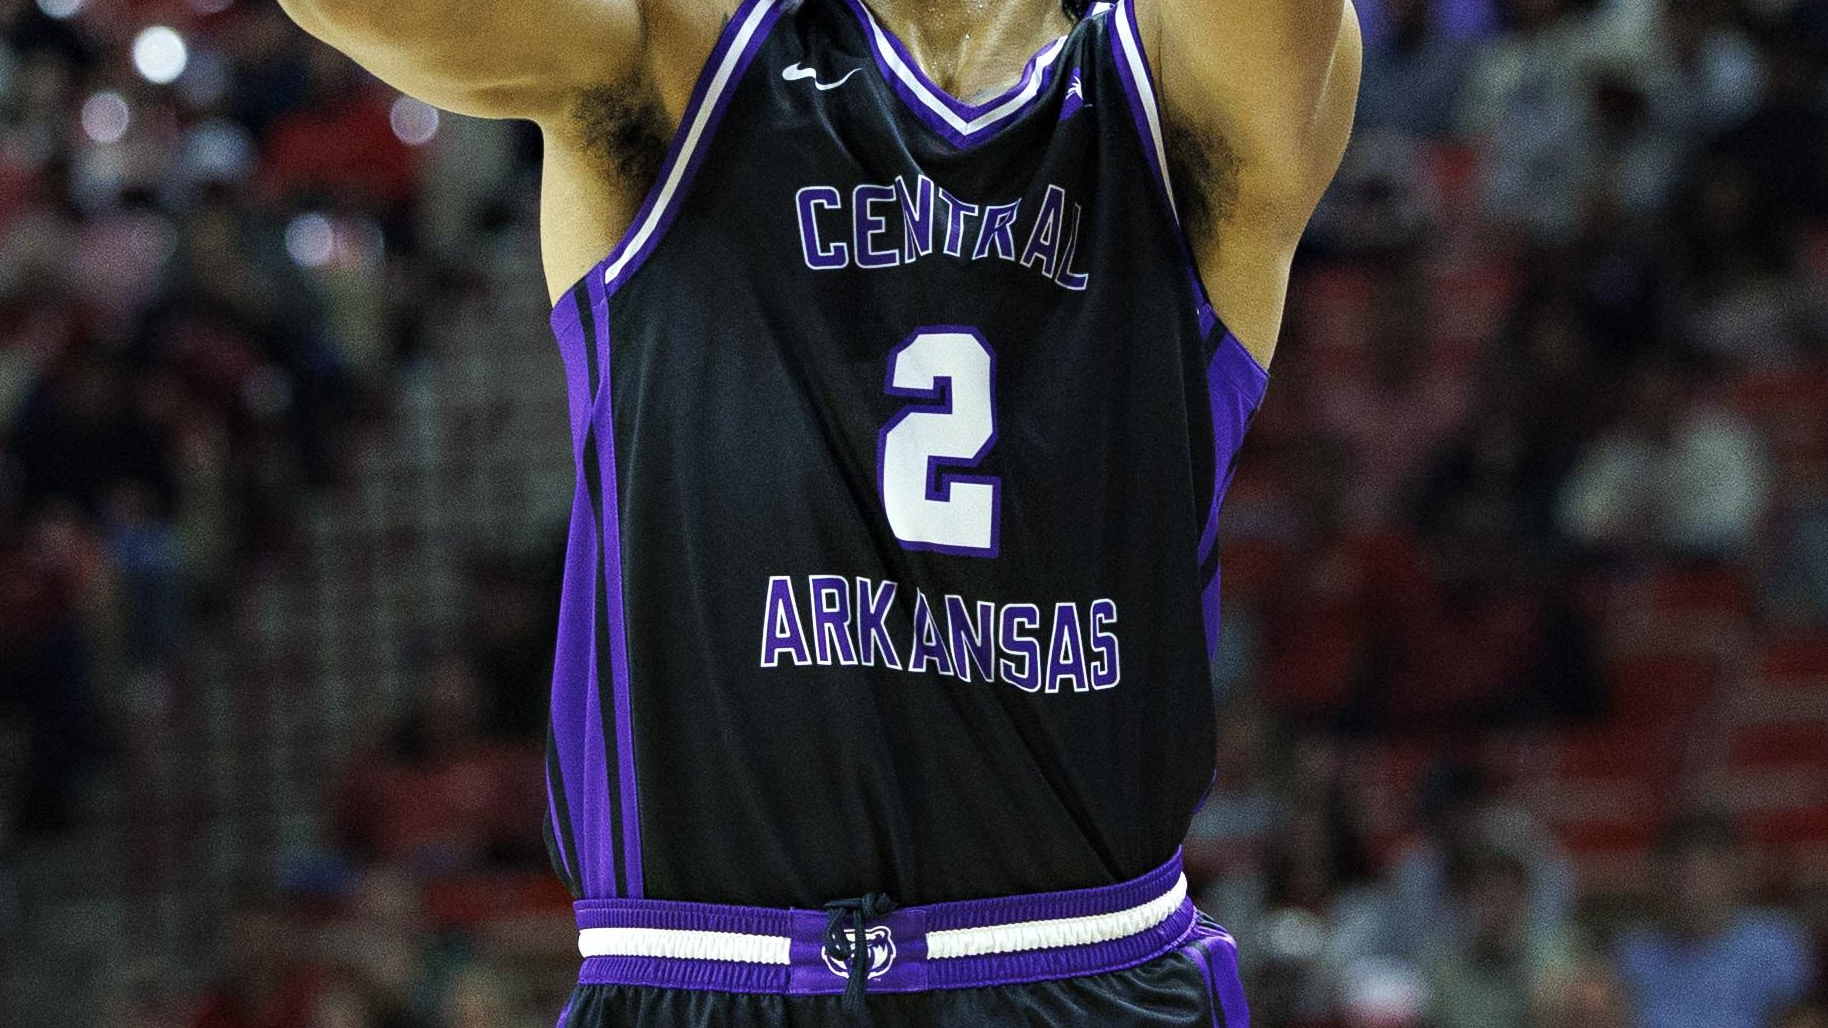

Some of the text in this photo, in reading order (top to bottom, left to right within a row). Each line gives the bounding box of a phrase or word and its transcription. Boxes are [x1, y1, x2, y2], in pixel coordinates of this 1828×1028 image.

[796, 174, 1089, 290] CENTRAL
[877, 325, 1001, 558] 2
[760, 574, 1120, 693] ARKANSAS
